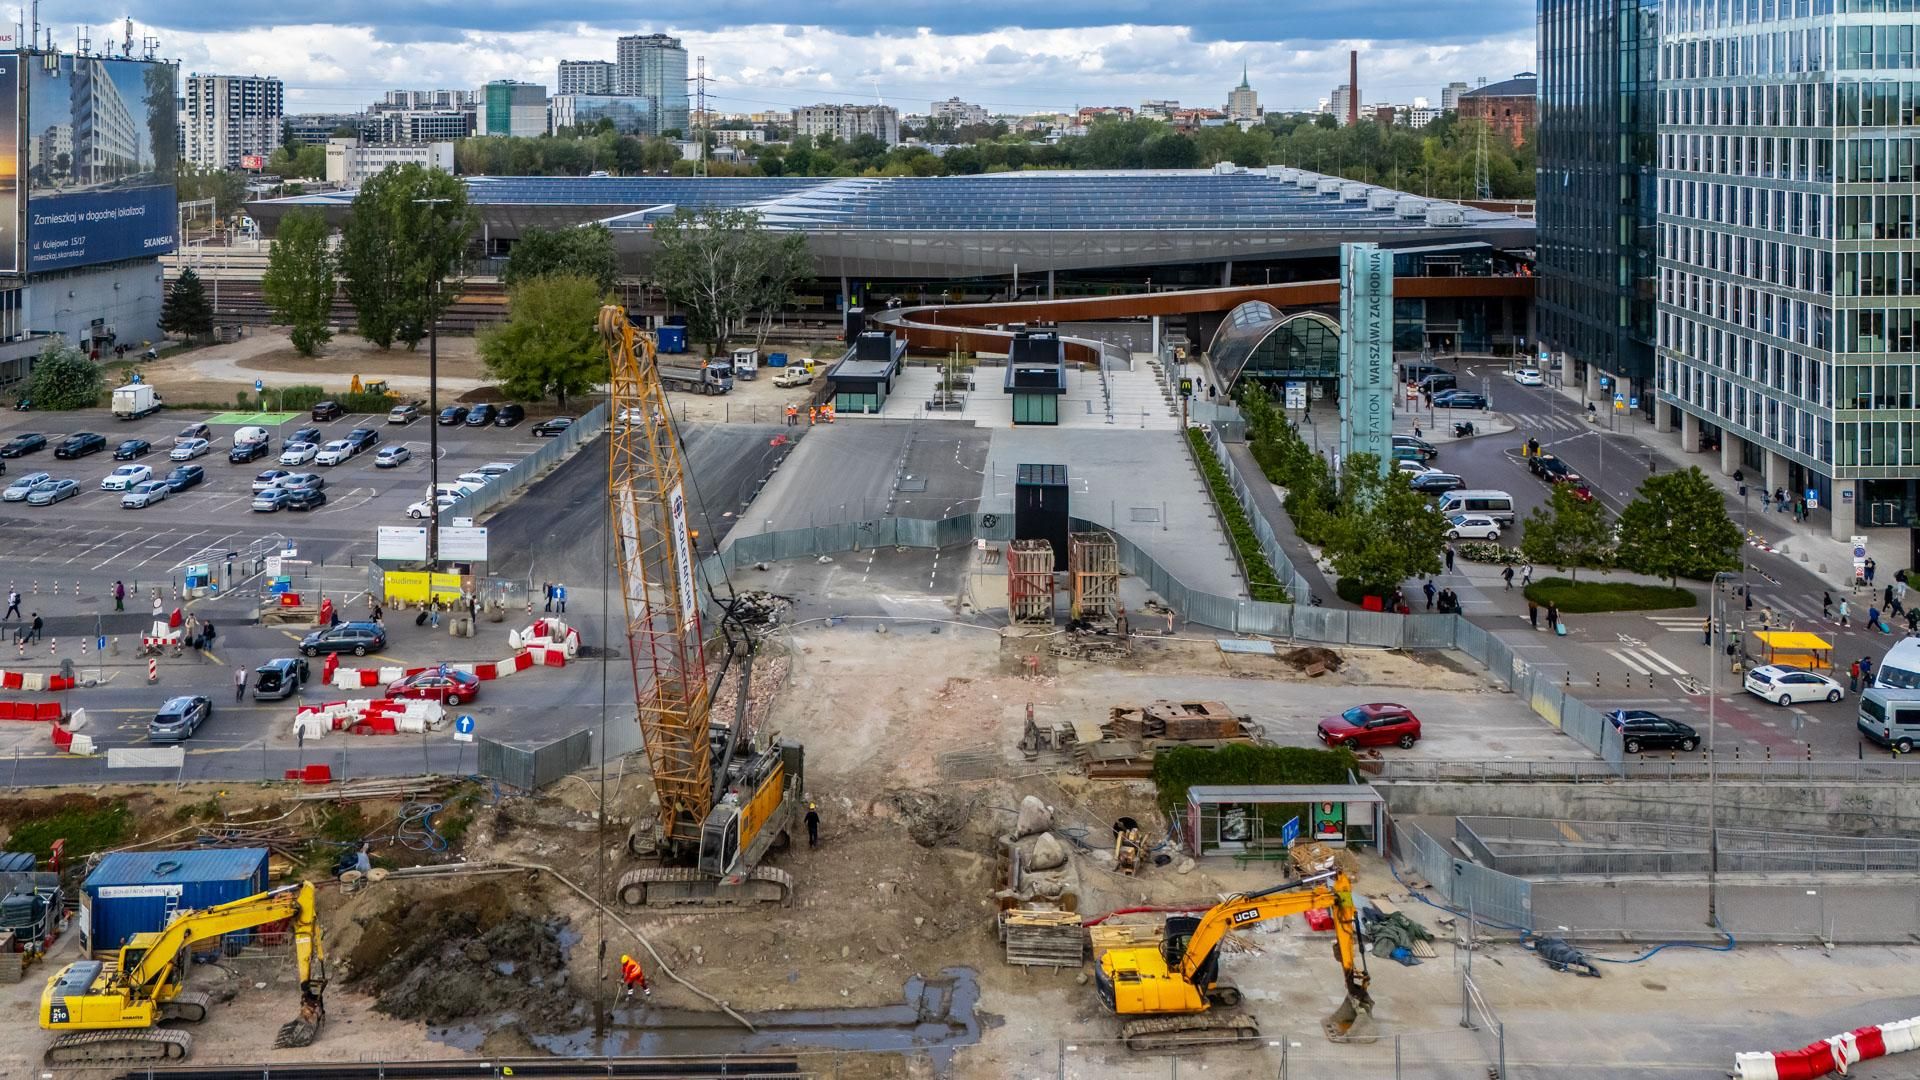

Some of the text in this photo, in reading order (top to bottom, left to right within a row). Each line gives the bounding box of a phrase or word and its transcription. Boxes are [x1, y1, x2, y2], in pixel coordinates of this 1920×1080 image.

[34, 205, 145, 225] Zamieszkaj w dogodnej lokalizacji
[43, 239, 69, 250] Kolejowa
[71, 236, 86, 246] 15/17
[143, 235, 173, 248] SKANSKA
[33, 248, 85, 261] mieszkaj.skanska.pl
[1370, 252, 1380, 318] ZACHODNIA
[1369, 321, 1380, 385] WARSZAWA
[1369, 394, 1380, 443] STATION
[1235, 909, 1258, 922] JCB
